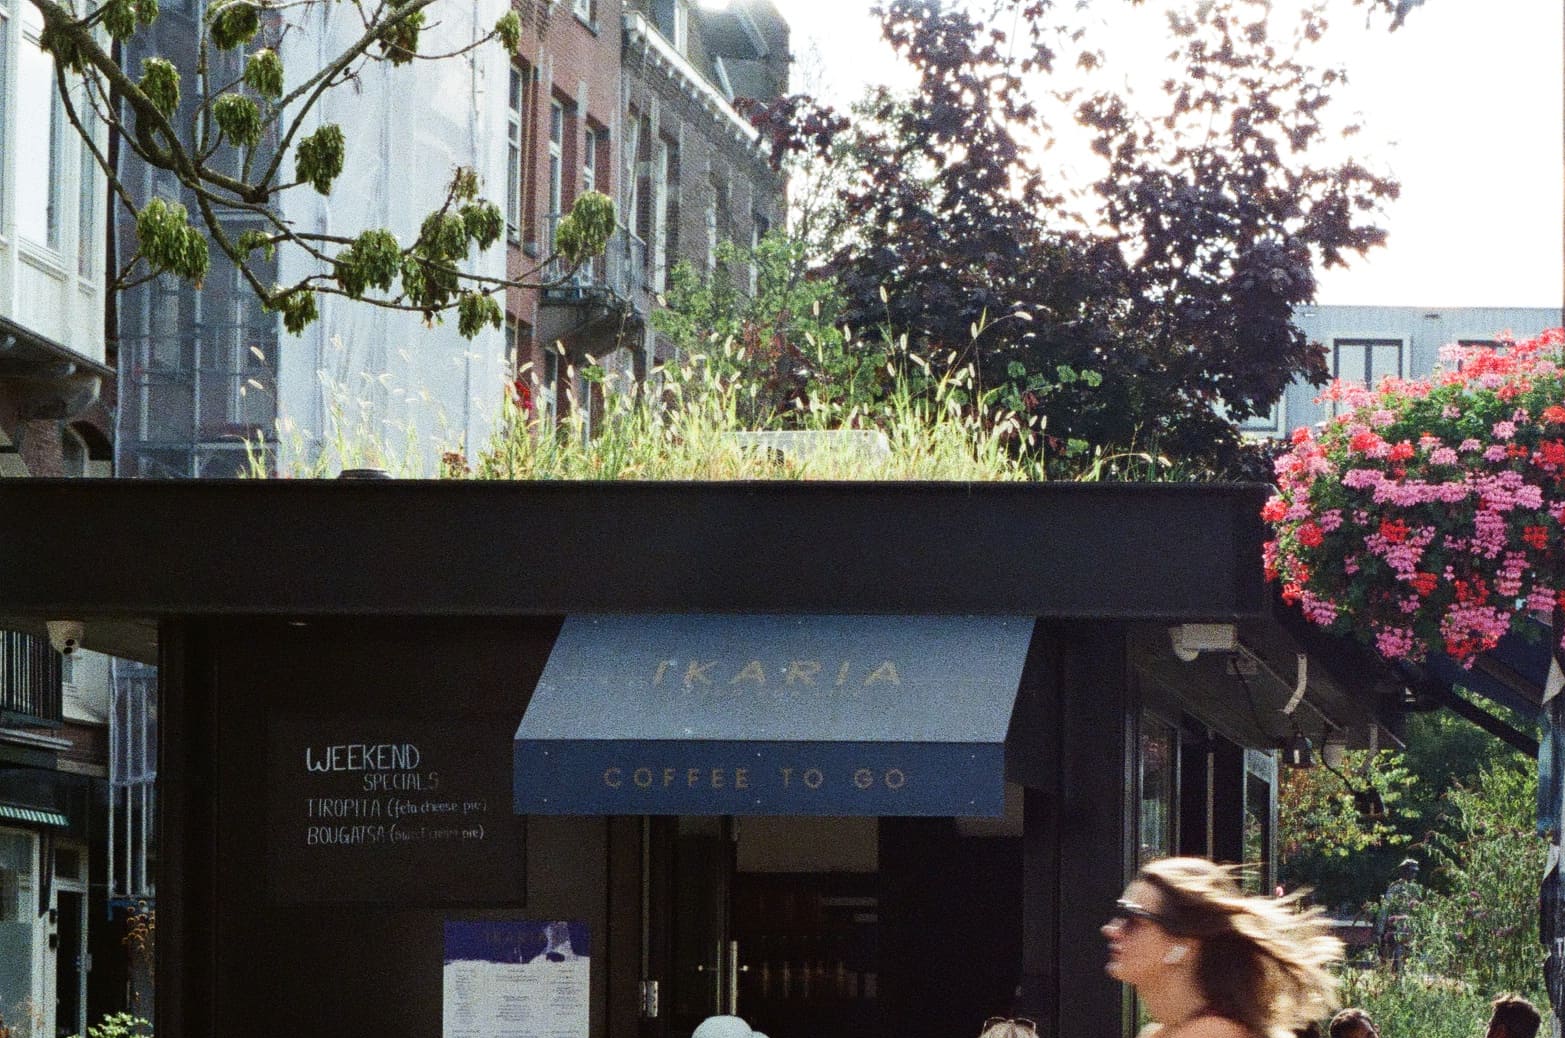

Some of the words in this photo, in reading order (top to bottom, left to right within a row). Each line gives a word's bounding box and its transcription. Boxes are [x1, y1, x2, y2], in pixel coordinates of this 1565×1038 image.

[654, 659, 901, 686] IKARIA
[306, 744, 421, 772] WEEKEND
[363, 771, 439, 791] SPECIALS
[603, 767, 749, 789] COFFEE
[780, 767, 824, 790] TO
[853, 767, 905, 790] GO
[307, 798, 381, 817] TIROPITA
[307, 825, 386, 845] BOUGATSA
